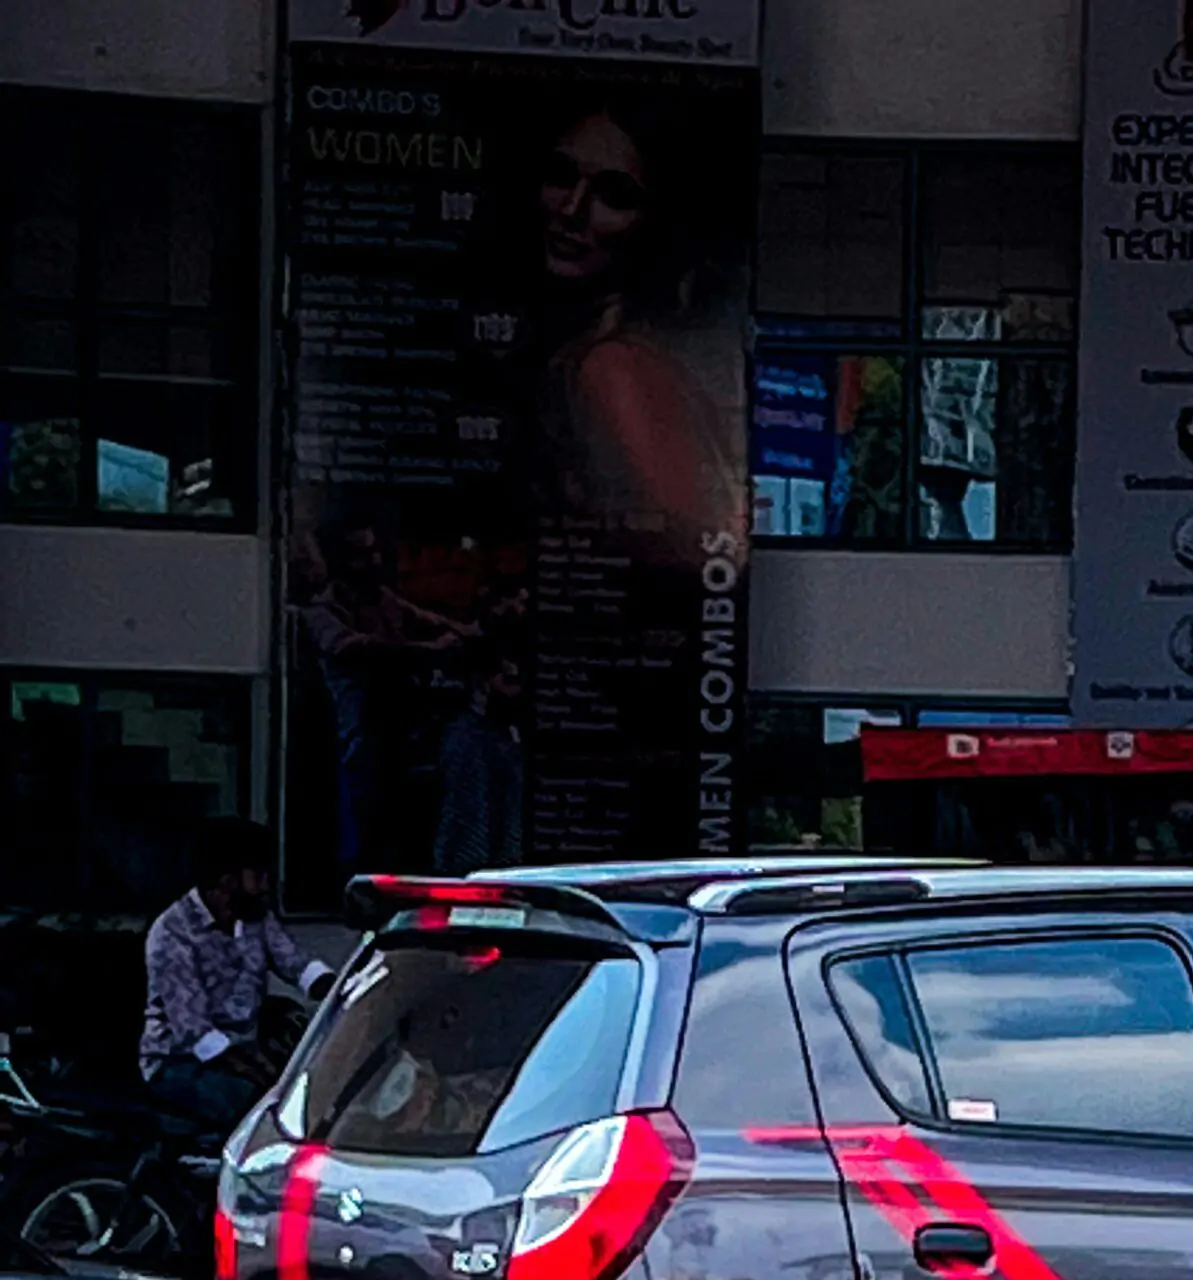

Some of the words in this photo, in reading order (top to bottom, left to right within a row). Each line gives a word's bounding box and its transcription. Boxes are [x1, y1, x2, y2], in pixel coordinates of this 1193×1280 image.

[305, 126, 484, 170] WOMEN
[700, 531, 737, 734] COMBOS
[699, 752, 732, 853] MEN
